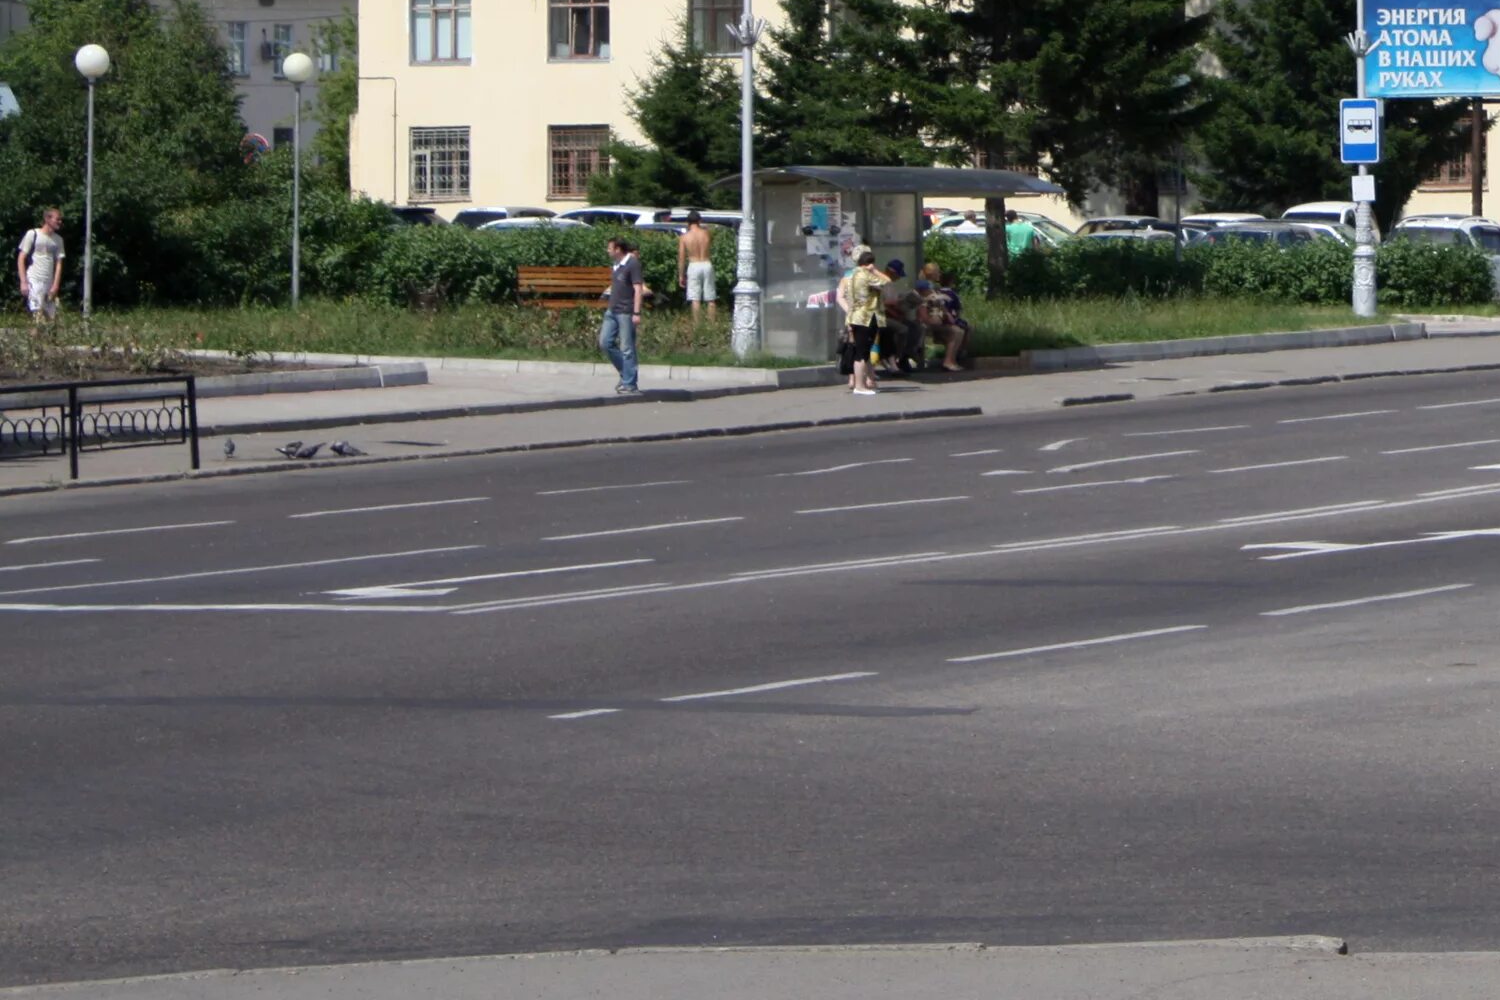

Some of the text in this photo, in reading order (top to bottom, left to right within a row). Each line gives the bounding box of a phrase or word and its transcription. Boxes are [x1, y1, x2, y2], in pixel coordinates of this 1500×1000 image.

[1376, 8, 1466, 26] ЭНЕРГИЯ
[1379, 29, 1453, 46] АТОМА
[1378, 50, 1477, 67] В НАШИХ
[1379, 71, 1444, 88] РУКАХ
